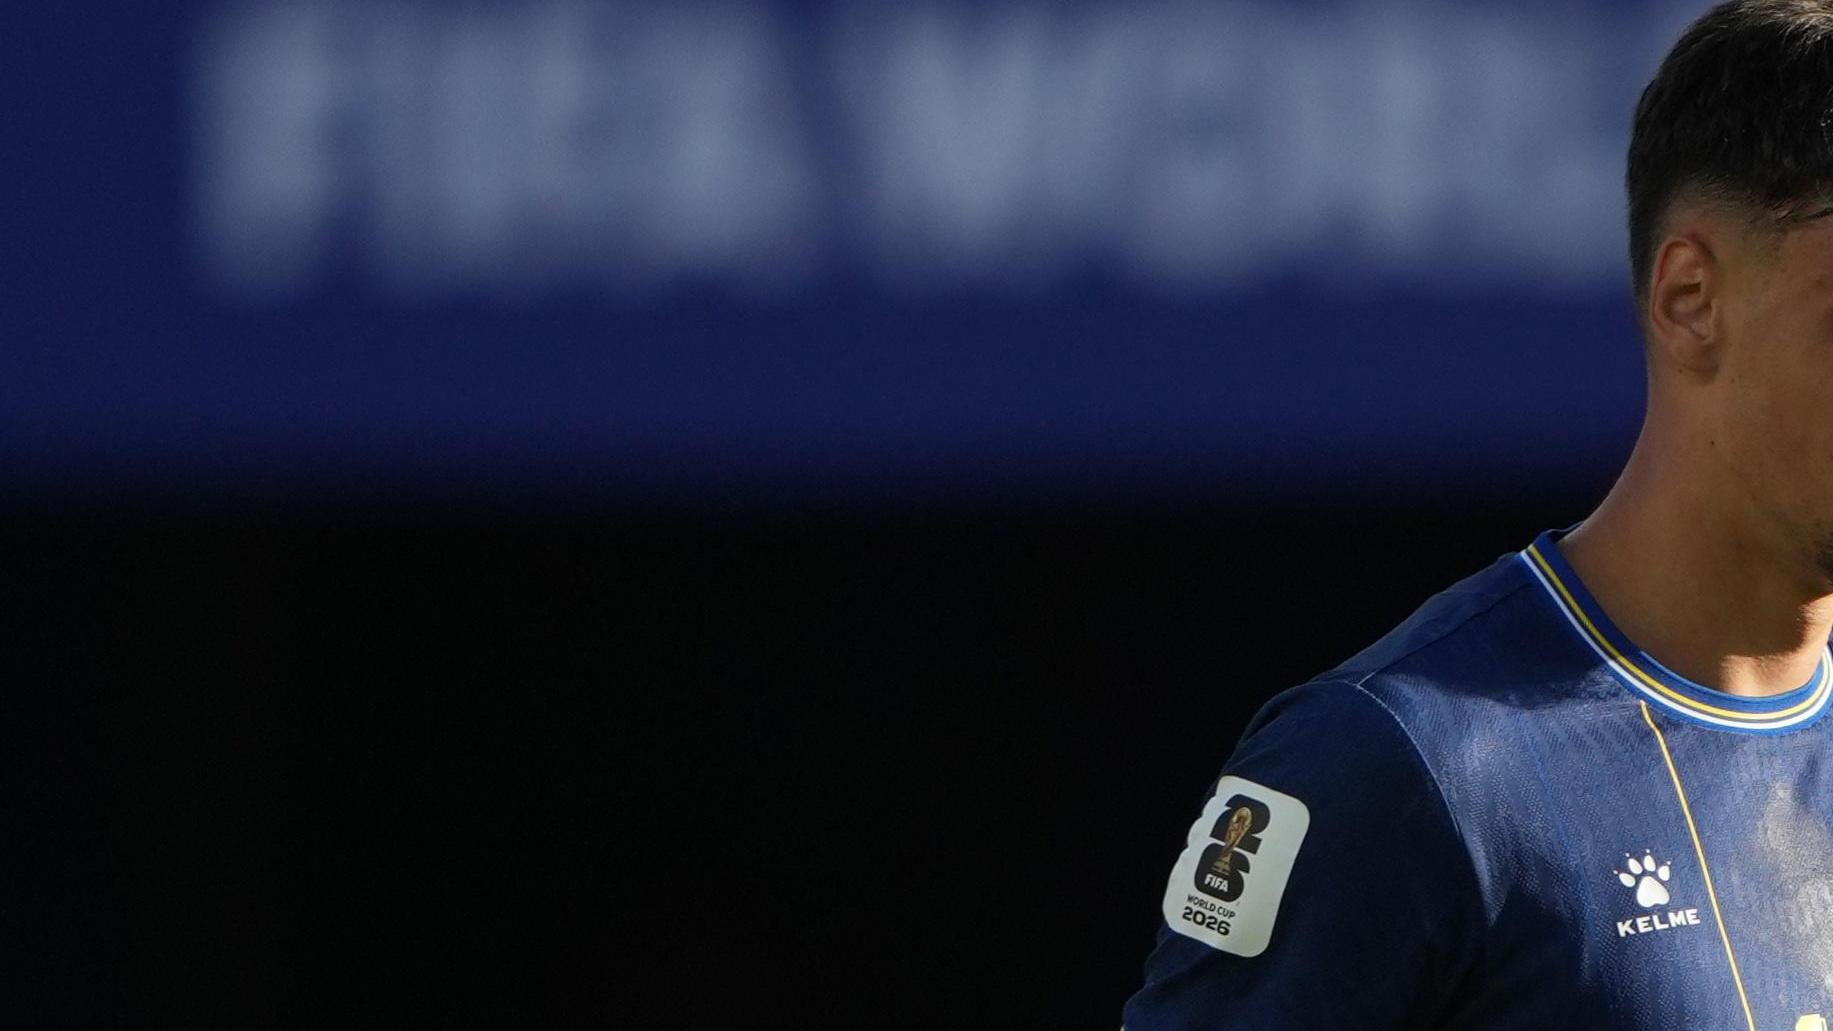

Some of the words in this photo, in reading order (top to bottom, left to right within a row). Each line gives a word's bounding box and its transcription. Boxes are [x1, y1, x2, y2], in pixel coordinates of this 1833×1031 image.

[198, 0, 818, 285] FIFA
[1204, 874, 1229, 892] FIFA
[1182, 906, 1231, 936] 2026
[1187, 894, 1216, 914] WORLD
[1217, 905, 1236, 920] CUP
[1616, 908, 1701, 938] KELME
